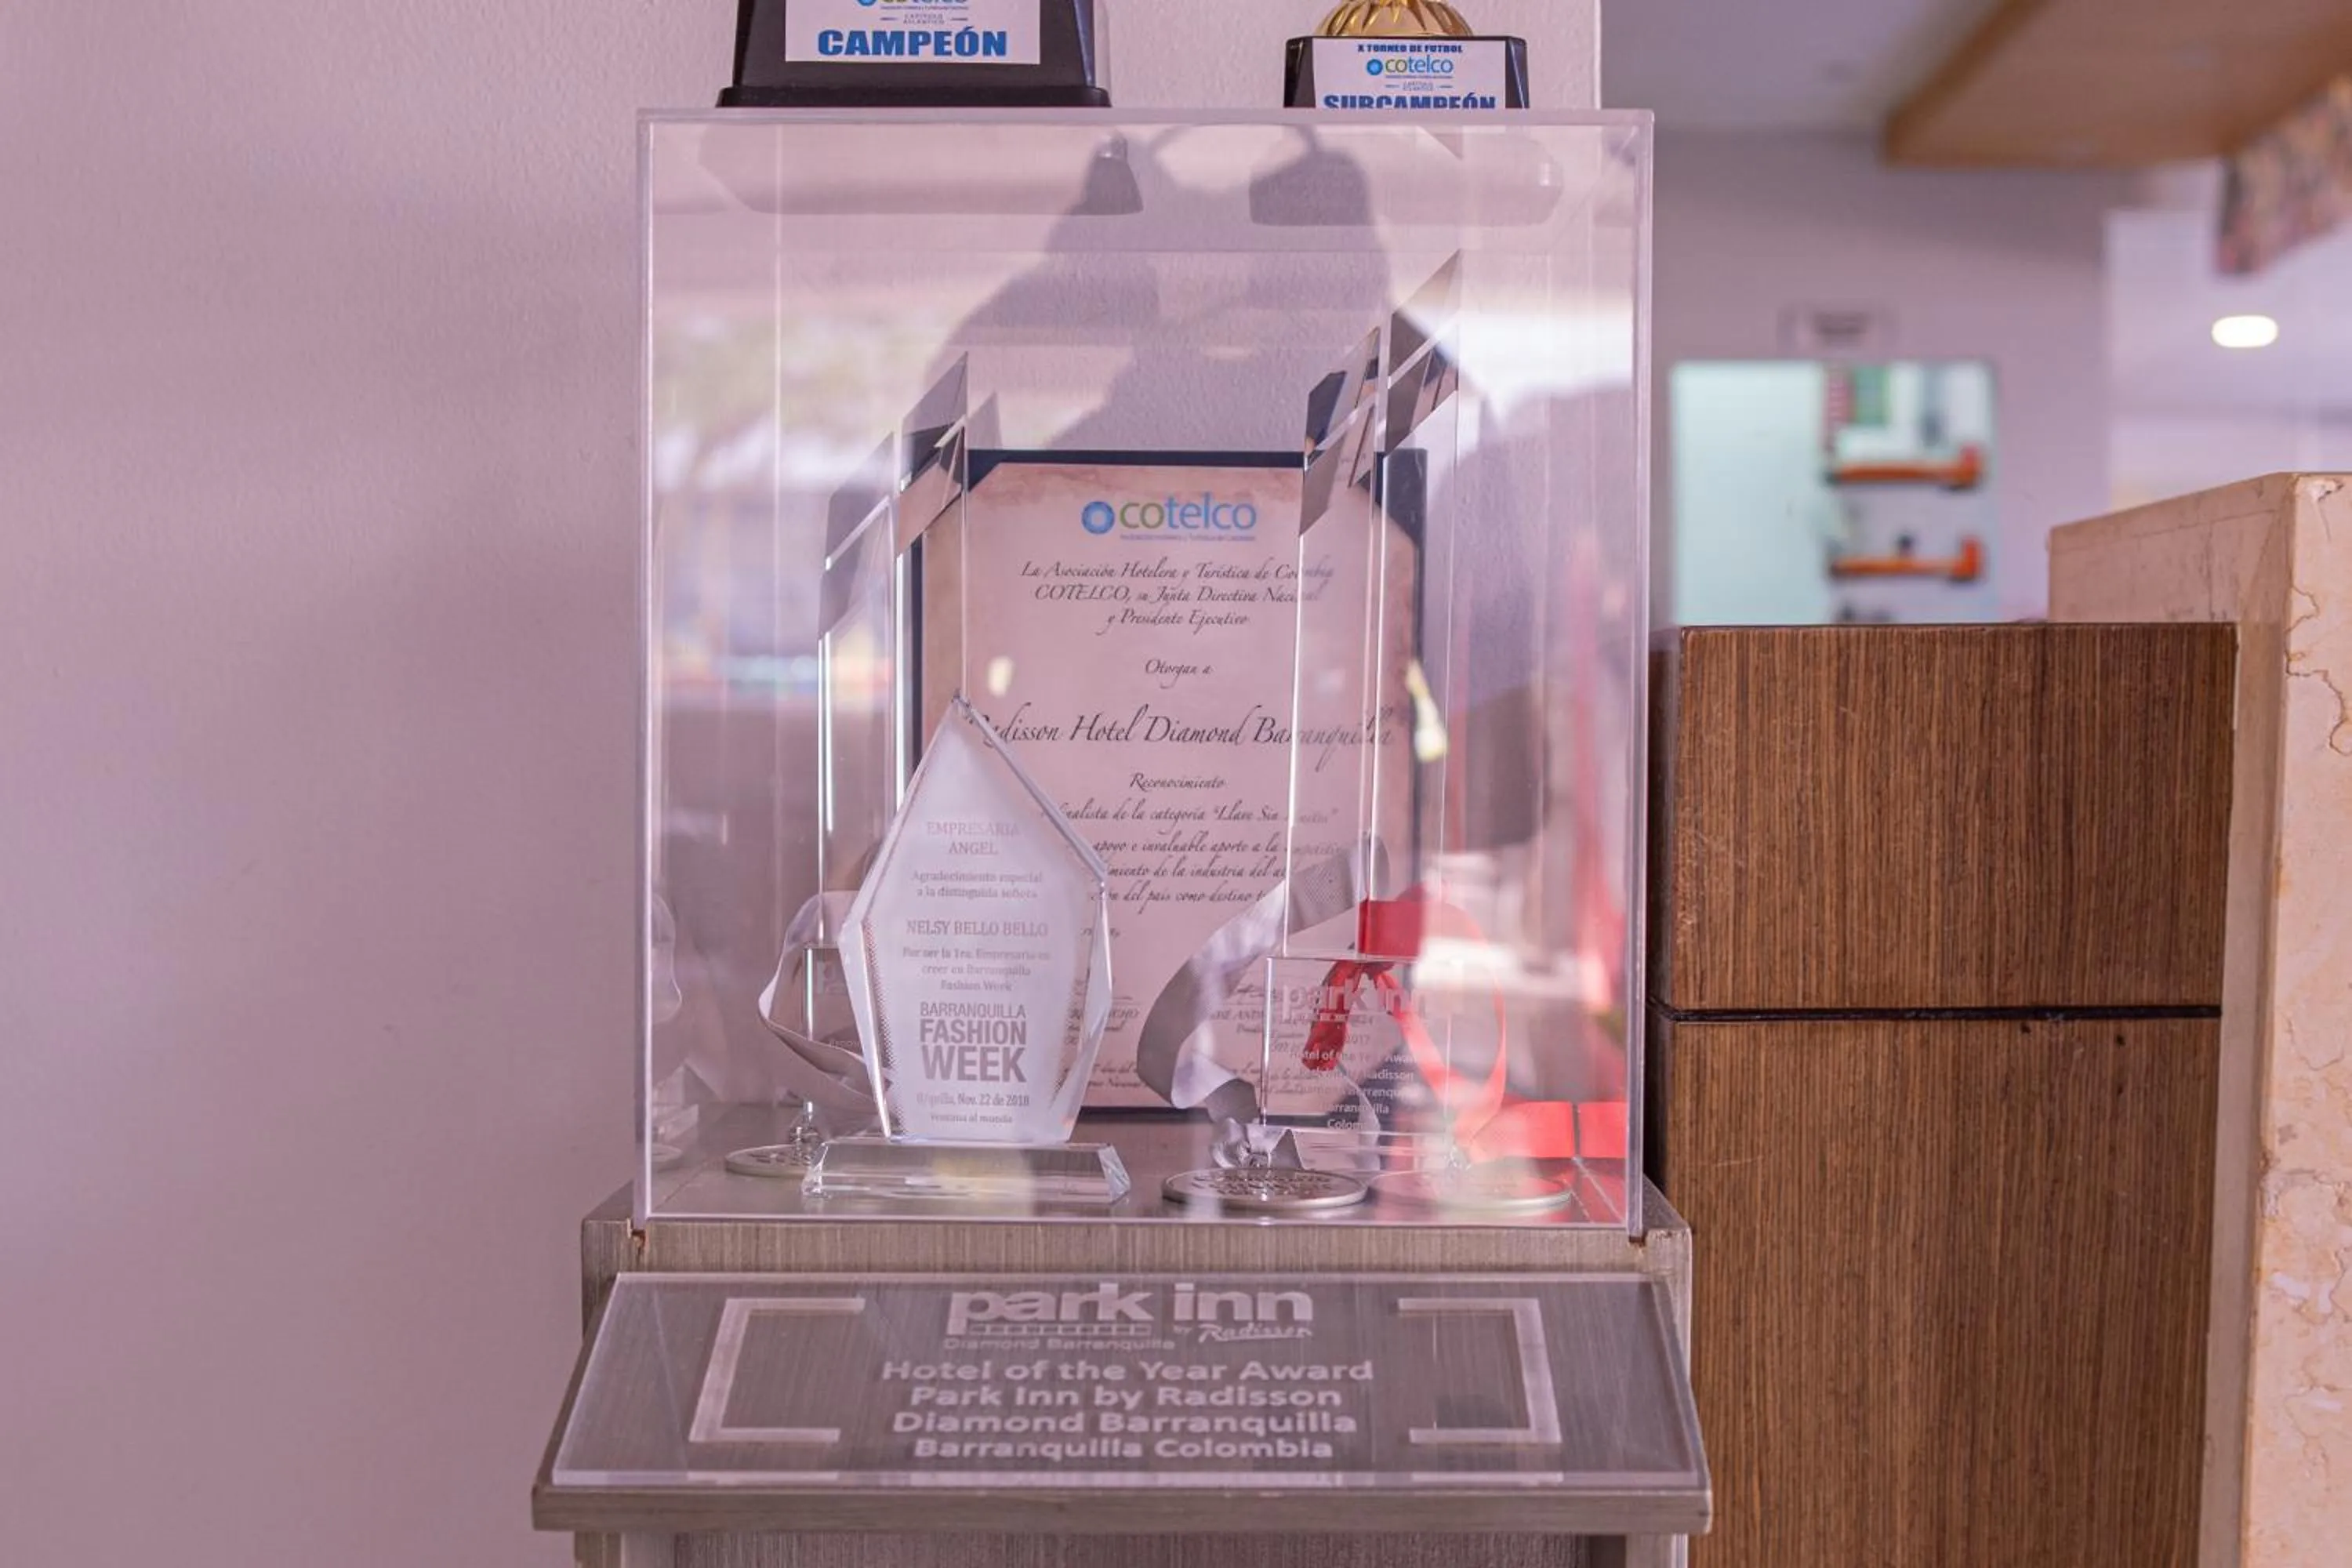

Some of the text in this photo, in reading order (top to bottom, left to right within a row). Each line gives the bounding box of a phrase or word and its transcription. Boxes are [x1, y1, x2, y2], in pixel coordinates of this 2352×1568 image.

[818, 27, 1007, 56] CAMPEÓN
[1367, 44, 1406, 53] TORNEO
[1409, 44, 1422, 53] DE
[1385, 55, 1454, 74] cotelco
[1119, 495, 1257, 530] cotelco
[1022, 561, 1041, 577] La
[1044, 560, 1115, 579] Asociación
[1120, 556, 1178, 579] Hotelera
[1196, 561, 1250, 579] Turística
[1254, 557, 1274, 580] de
[1034, 579, 1330, 605] COTELCO, su Junta Directiva Nacinal
[1095, 606, 1249, 637] y Presidente Ejecutivo
[1145, 659, 1212, 689] Otorgan a
[1069, 703, 1149, 742] Hotel
[1143, 704, 1262, 746] Diamond
[1129, 771, 1225, 792] Reconocimiento
[1112, 797, 1130, 821] de
[1131, 798, 1146, 821] la
[1257, 804, 1278, 822] Sin
[927, 822, 1020, 836] EMPRESARIA
[947, 840, 1000, 855] ANGEL
[1131, 841, 1138, 852] e
[1142, 829, 1208, 852] invaluable
[1210, 840, 1248, 862] aporte
[1252, 843, 1261, 852] a
[1265, 831, 1280, 852] la
[911, 870, 1043, 886] Agradecimiento especial
[1152, 855, 1172, 878] de
[1172, 855, 1186, 878] la
[1190, 855, 1244, 878] industria
[1249, 855, 1277, 878] del
[926, 886, 936, 897] la
[937, 887, 998, 900] distinguida
[1123, 879, 1151, 902] del
[1175, 890, 1206, 902] como
[1208, 879, 1252, 902] destino
[906, 920, 1048, 938] NELSY BELLO BELLO
[922, 949, 940, 959] ser
[942, 947, 952, 959] la
[975, 948, 1035, 961] Empresaria
[921, 964, 1032, 978] creer en Barranquilla
[940, 980, 1013, 992] Fashion Week
[920, 1001, 1027, 1019] BARRANQUILLA
[920, 1018, 1027, 1045] FASHION
[921, 1044, 1027, 1083] WEEK
[979, 1093, 991, 1105] 22
[993, 1091, 1004, 1105] de
[946, 1283, 1314, 1335] park inn
[1198, 1322, 1314, 1343] Radisson
[943, 1338, 1175, 1351] Diamond Barranquilla
[882, 1359, 1374, 1381] Hotel of the Year Award
[910, 1385, 1342, 1410] Park Inn by Radisson
[893, 1411, 1357, 1438] Diamond Barranquilla
[914, 1438, 1334, 1462] Barranquilla Colombia
